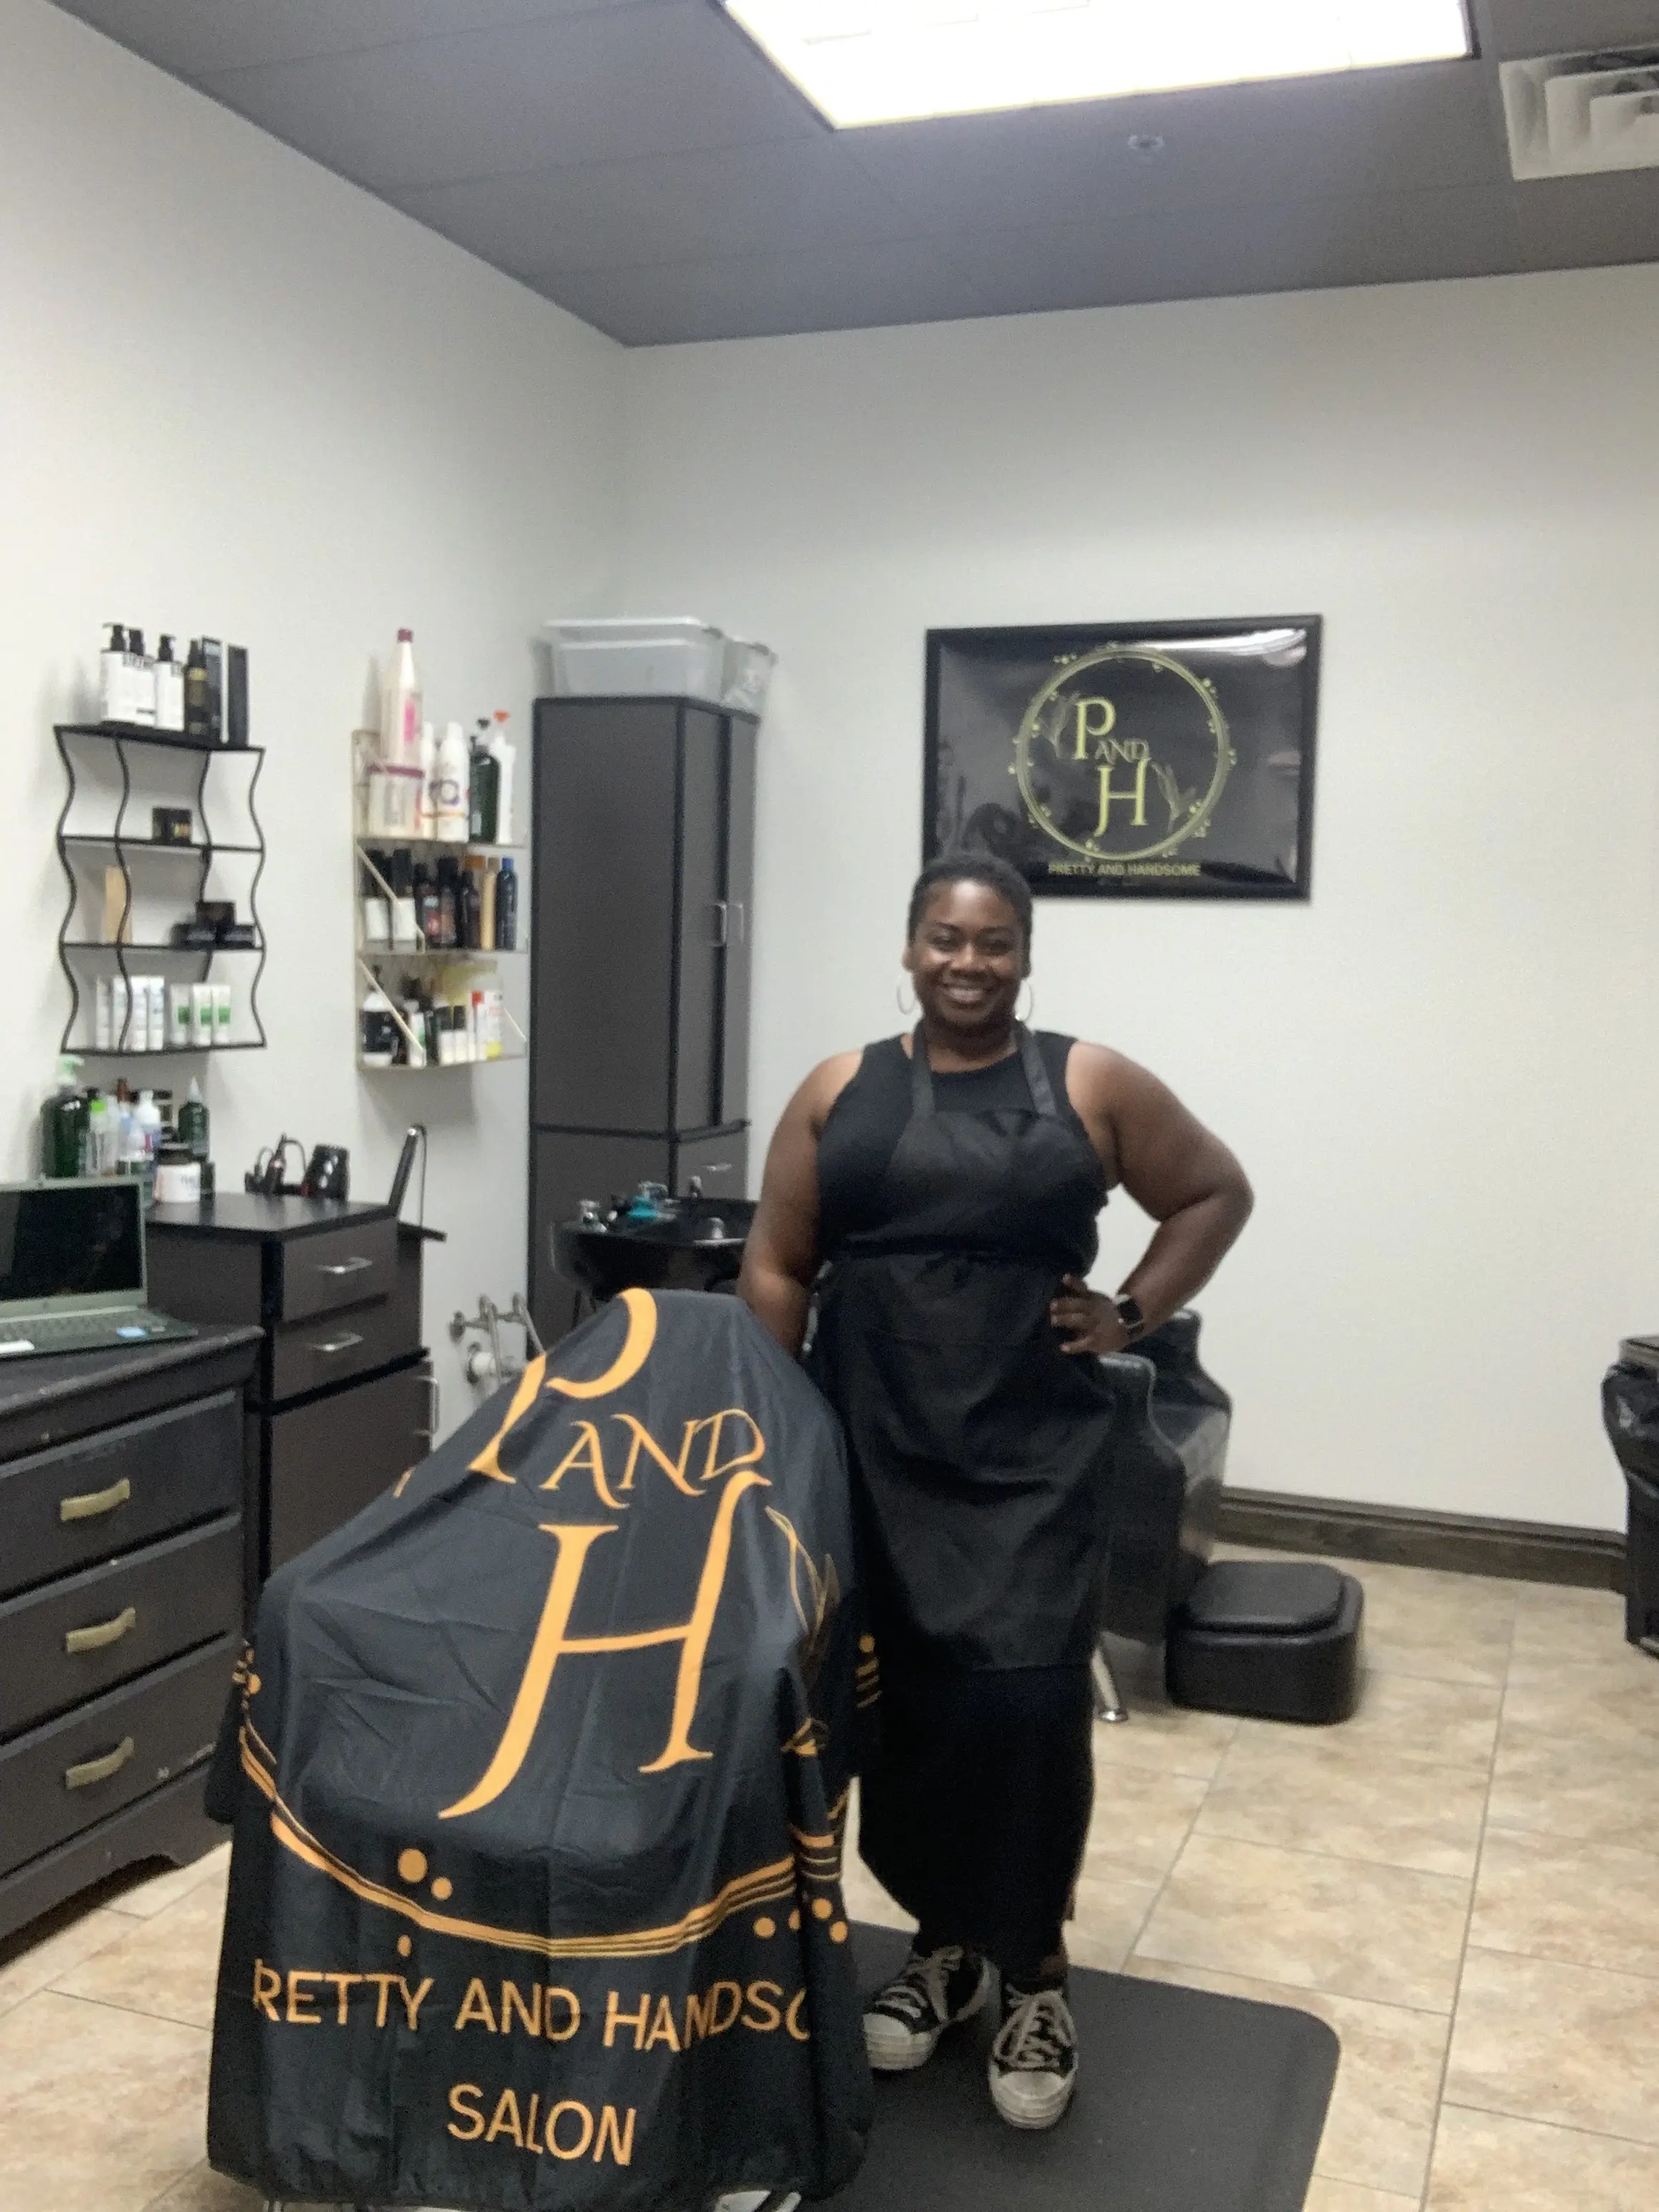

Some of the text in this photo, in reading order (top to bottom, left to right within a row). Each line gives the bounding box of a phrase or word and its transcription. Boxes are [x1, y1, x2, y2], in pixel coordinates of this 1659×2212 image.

[1072, 697, 1116, 759] P
[1095, 738, 1150, 765] AND
[1094, 757, 1152, 837] H
[1097, 863, 1125, 876] AND
[539, 1409, 765, 1509] AND
[438, 1471, 772, 1819] H
[253, 1958, 434, 2030] RETTY
[455, 1977, 581, 2042] AND
[447, 2083, 638, 2166] SALON
